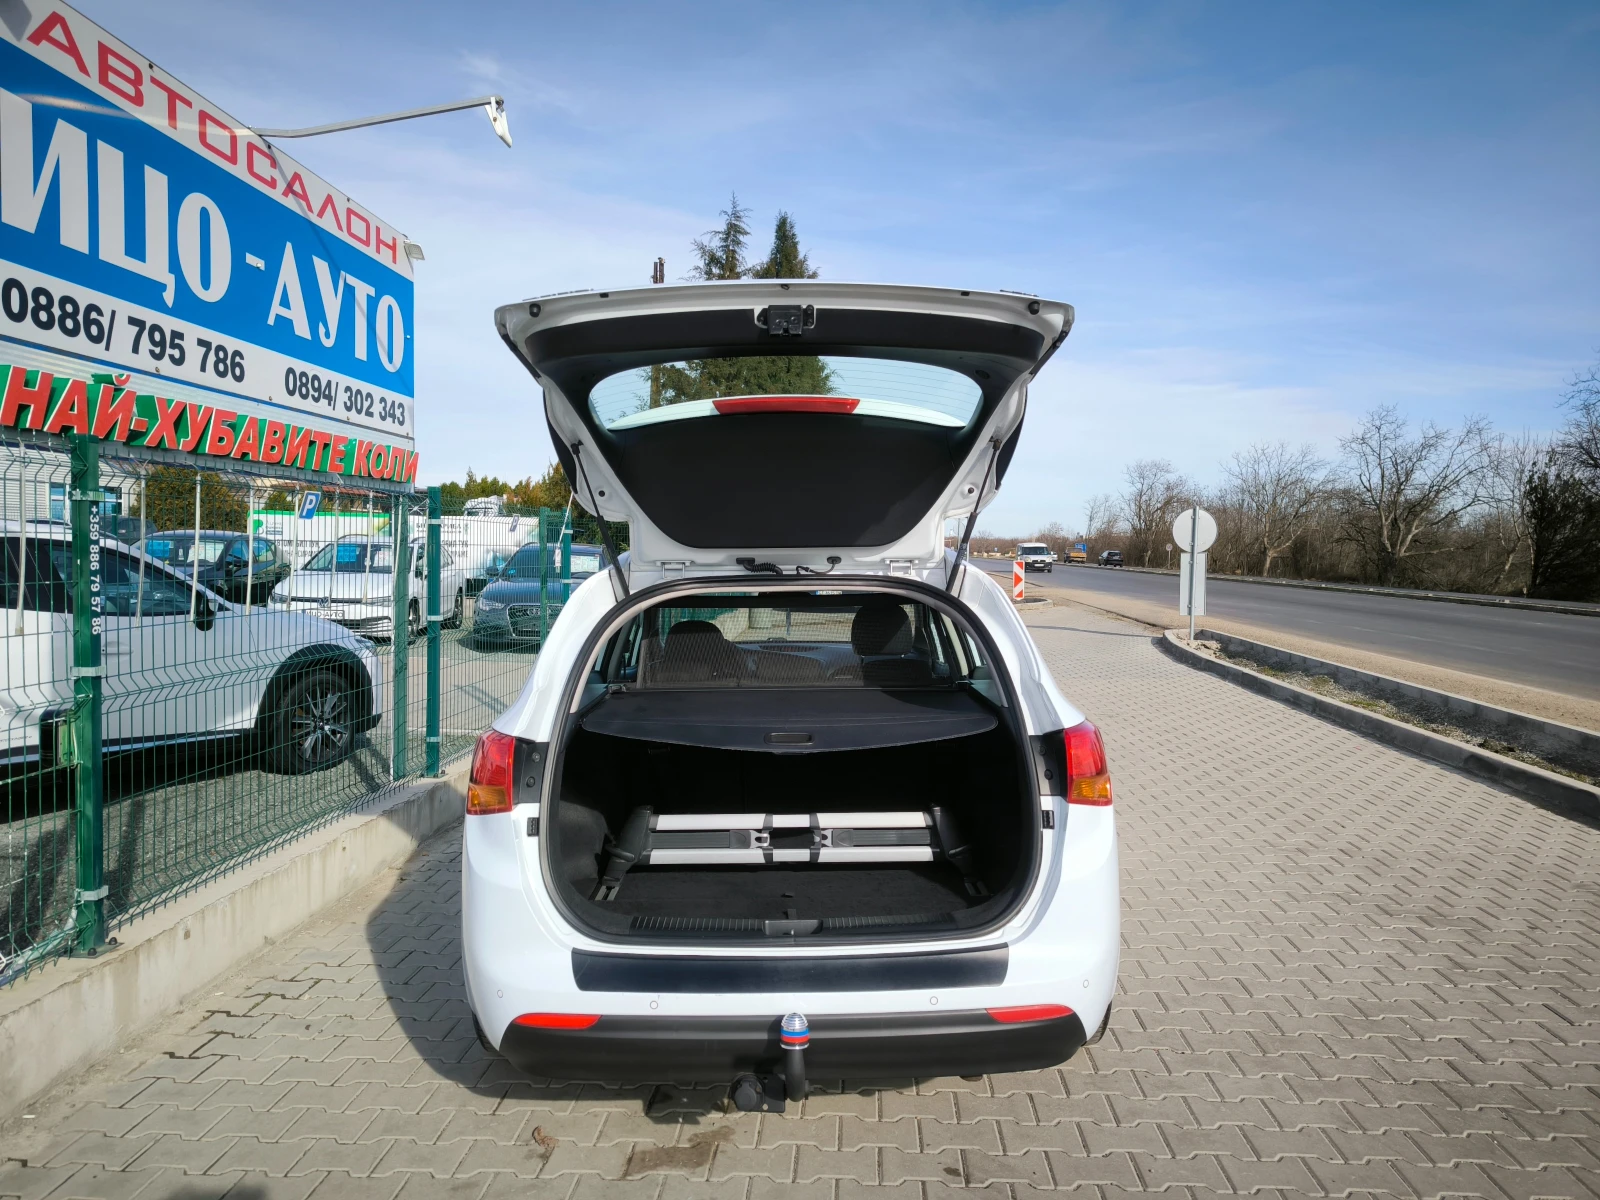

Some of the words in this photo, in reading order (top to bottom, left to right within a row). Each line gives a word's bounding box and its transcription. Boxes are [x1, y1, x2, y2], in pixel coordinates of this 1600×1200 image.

[27, 11, 397, 264] АВТОСАЛОН
[2, 278, 116, 351] 0886/
[128, 316, 186, 366] 795
[197, 338, 245, 382] 786
[285, 367, 339, 411] 0894/
[343, 385, 374, 418] 302
[379, 397, 406, 426] 343
[0, 365, 349, 474] НАЙ-ХУБАВИТЕ
[352, 438, 419, 484] КОЛИ
[302, 495, 317, 516] P
[89, 505, 100, 540] +359
[89, 544, 100, 570] 886
[90, 574, 100, 592] 79
[91, 596, 101, 612] 57
[91, 617, 102, 635] 86
